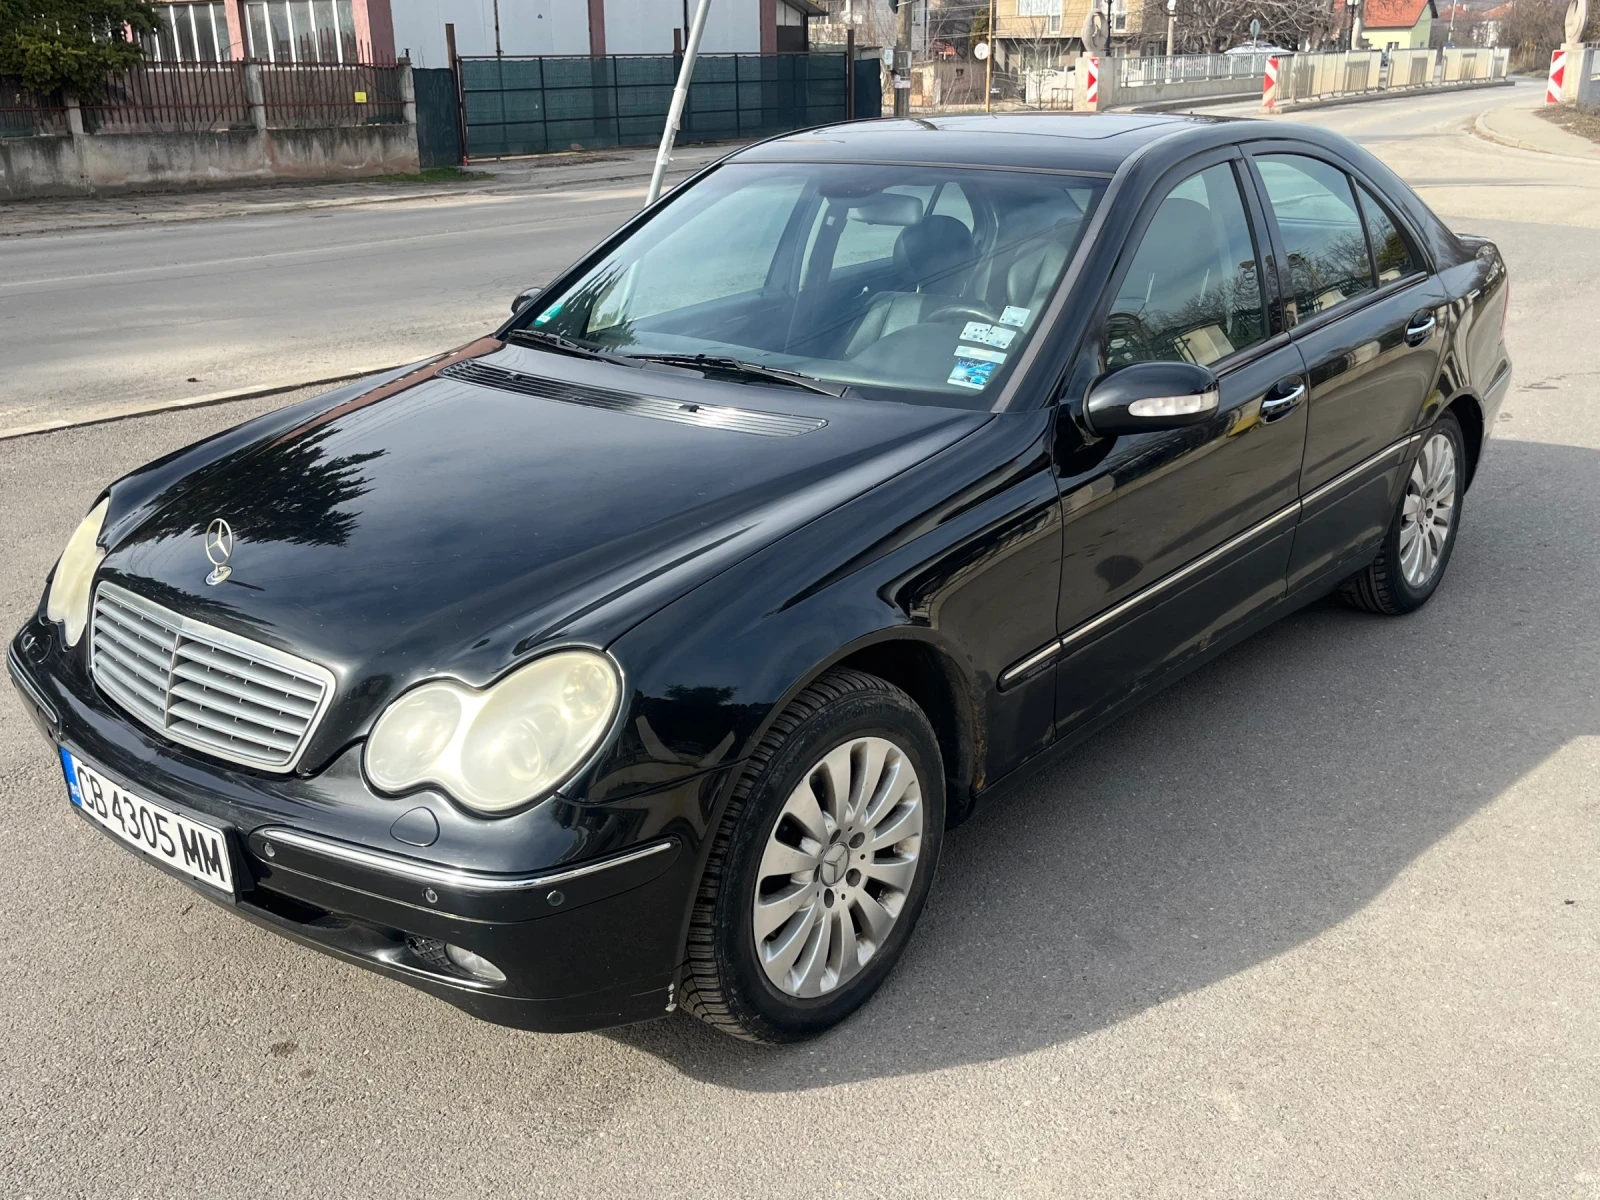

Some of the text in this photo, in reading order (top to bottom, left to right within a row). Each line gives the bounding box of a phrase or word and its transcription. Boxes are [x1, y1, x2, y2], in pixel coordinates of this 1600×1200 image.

[77, 766, 226, 882] CB 4305 MM
